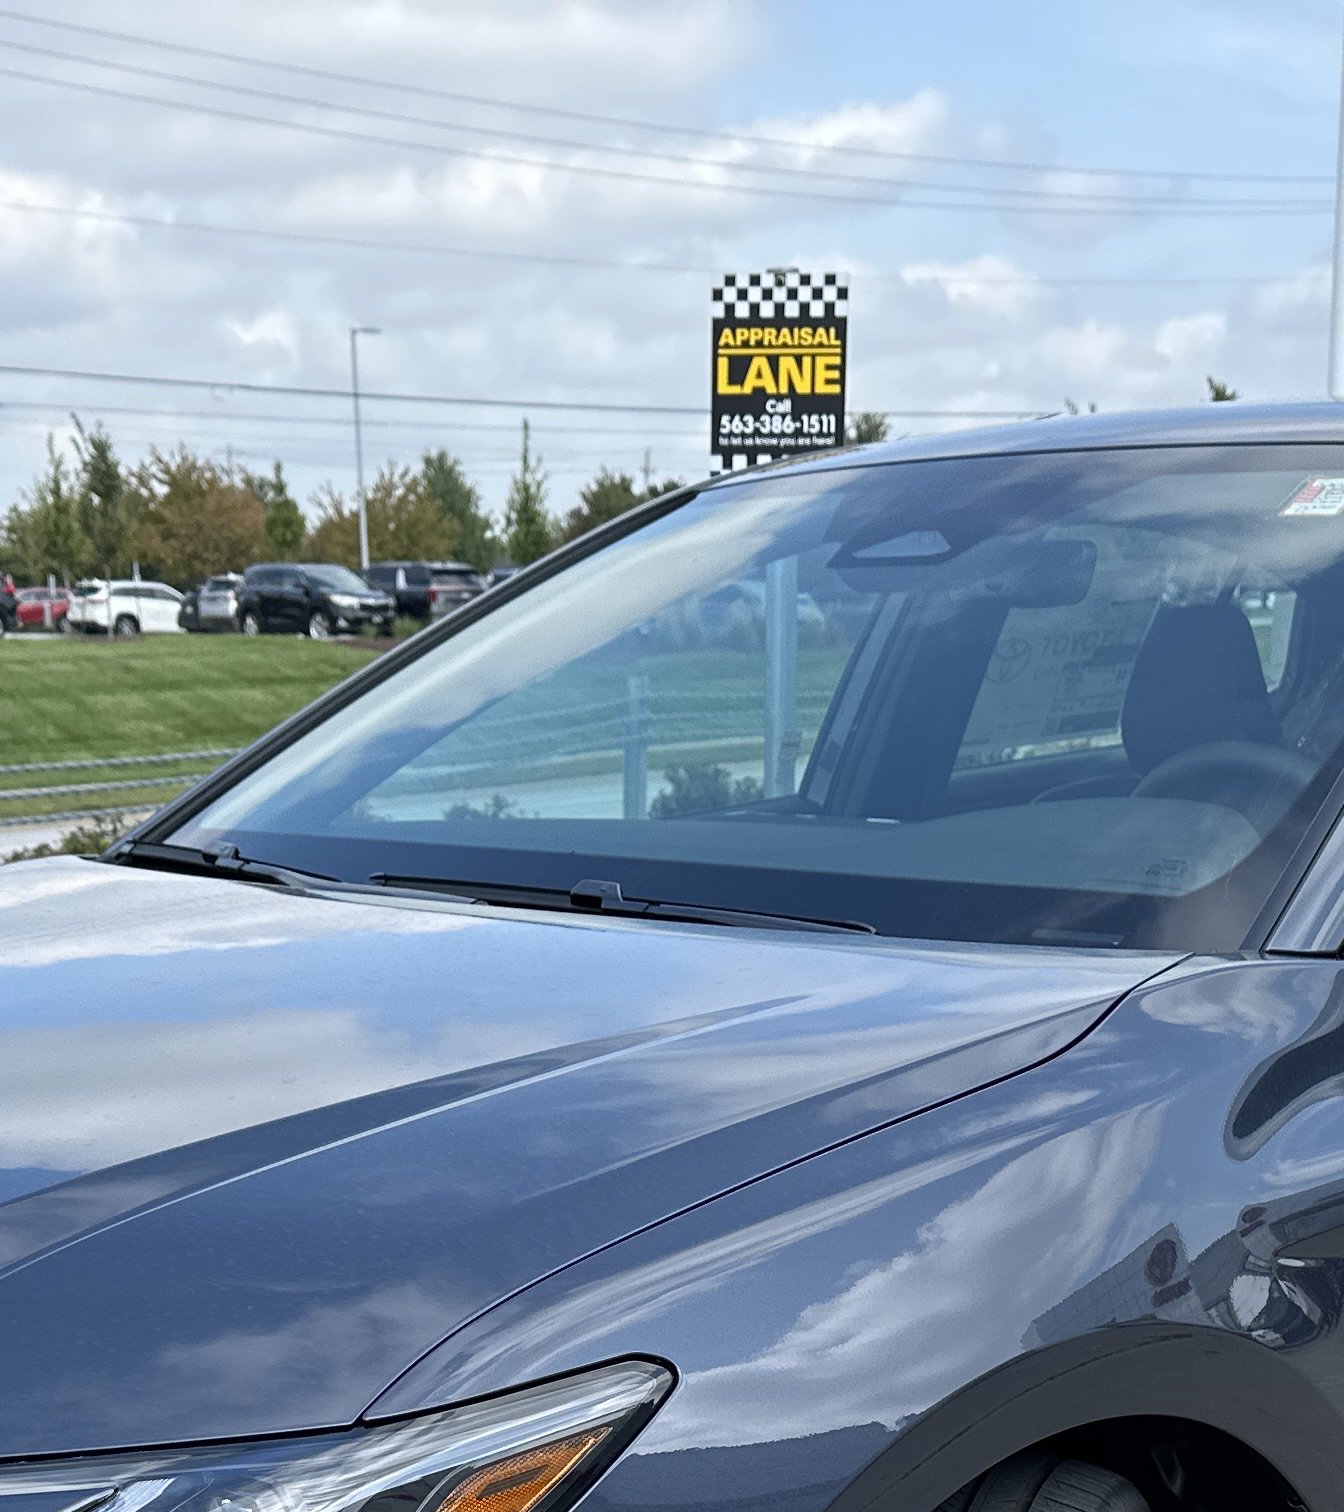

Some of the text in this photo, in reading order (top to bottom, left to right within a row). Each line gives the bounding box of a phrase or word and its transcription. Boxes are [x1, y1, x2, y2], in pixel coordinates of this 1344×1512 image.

[718, 327, 841, 346] APPRAISAL
[717, 355, 842, 394] LANE
[765, 398, 792, 414] Call
[719, 413, 836, 434] 563-386-1511
